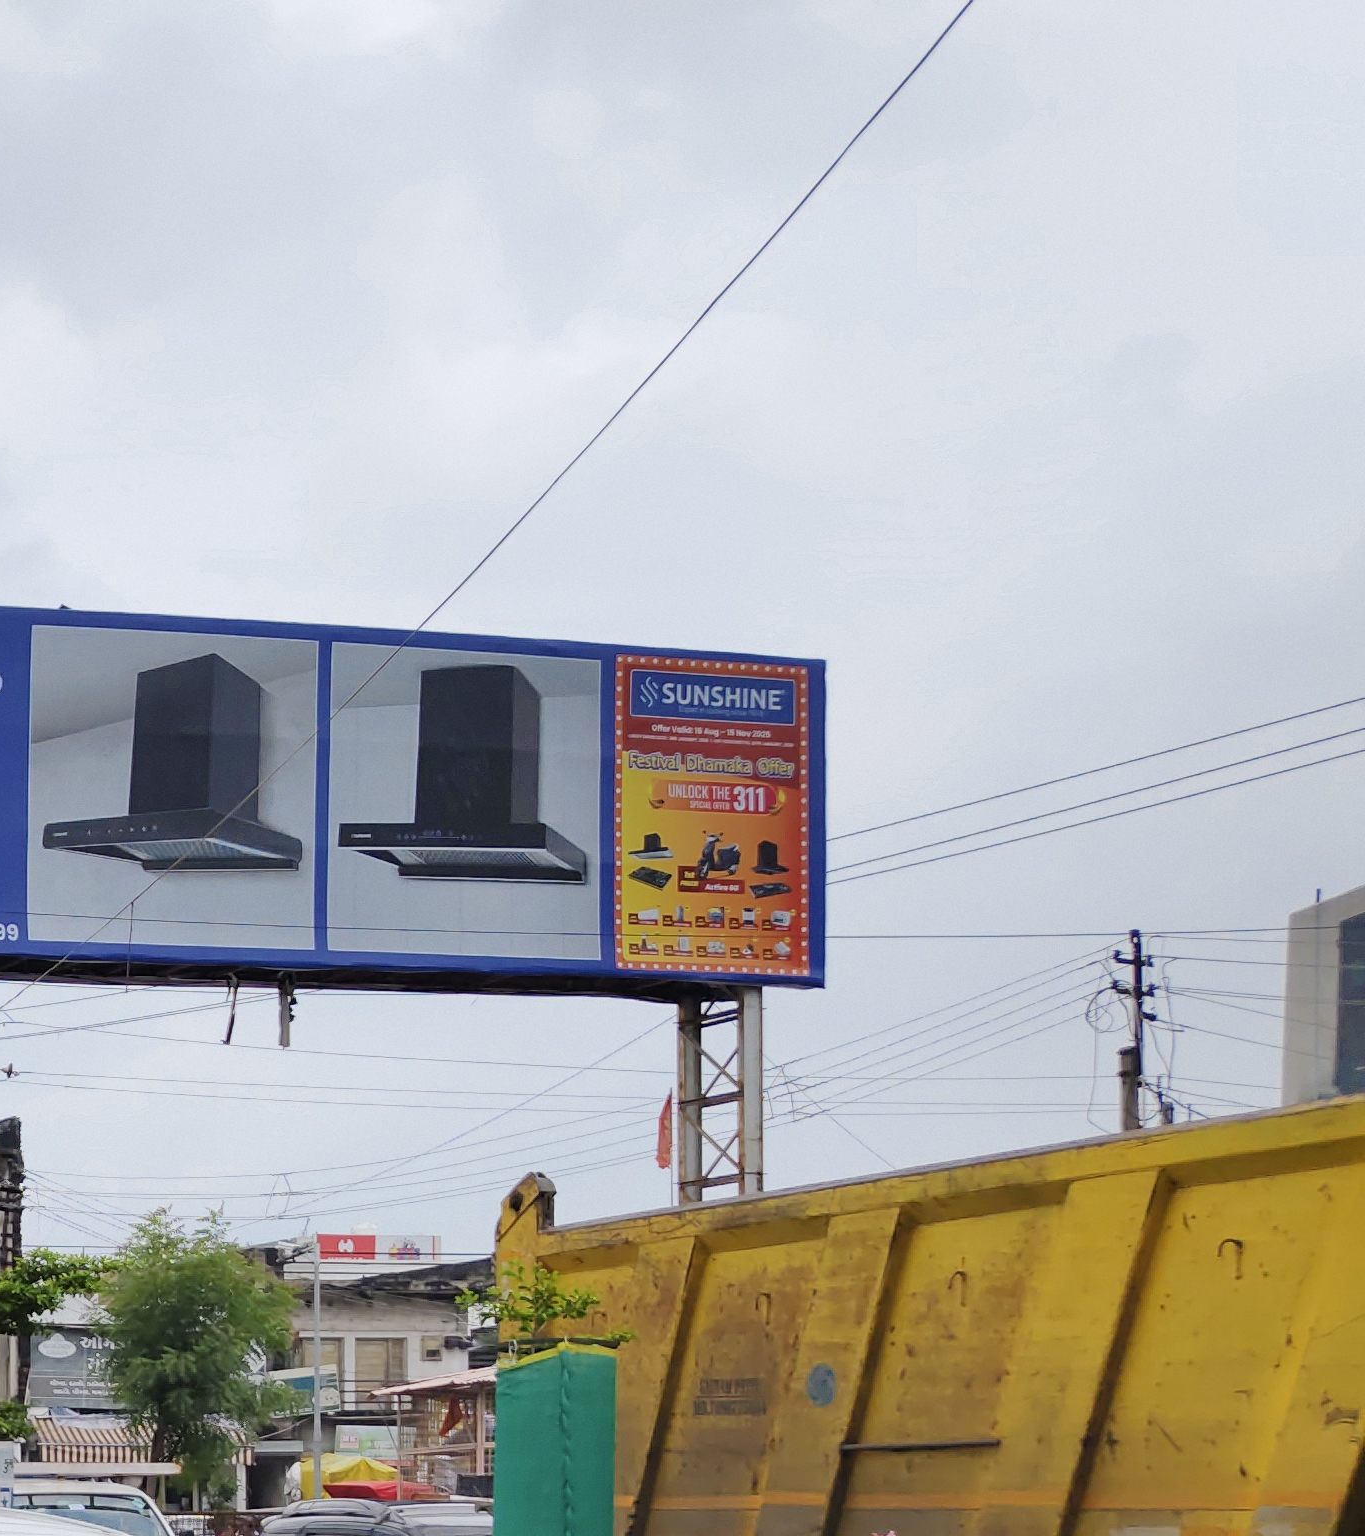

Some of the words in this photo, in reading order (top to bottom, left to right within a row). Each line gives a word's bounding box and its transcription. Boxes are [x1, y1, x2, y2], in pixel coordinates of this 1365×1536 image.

[628, 751, 681, 771] Festival
[685, 754, 752, 774] Dhamaka
[757, 757, 794, 778] Offer
[668, 784, 709, 799] UNLOCK
[711, 786, 731, 800] THE
[733, 786, 766, 812] 311
